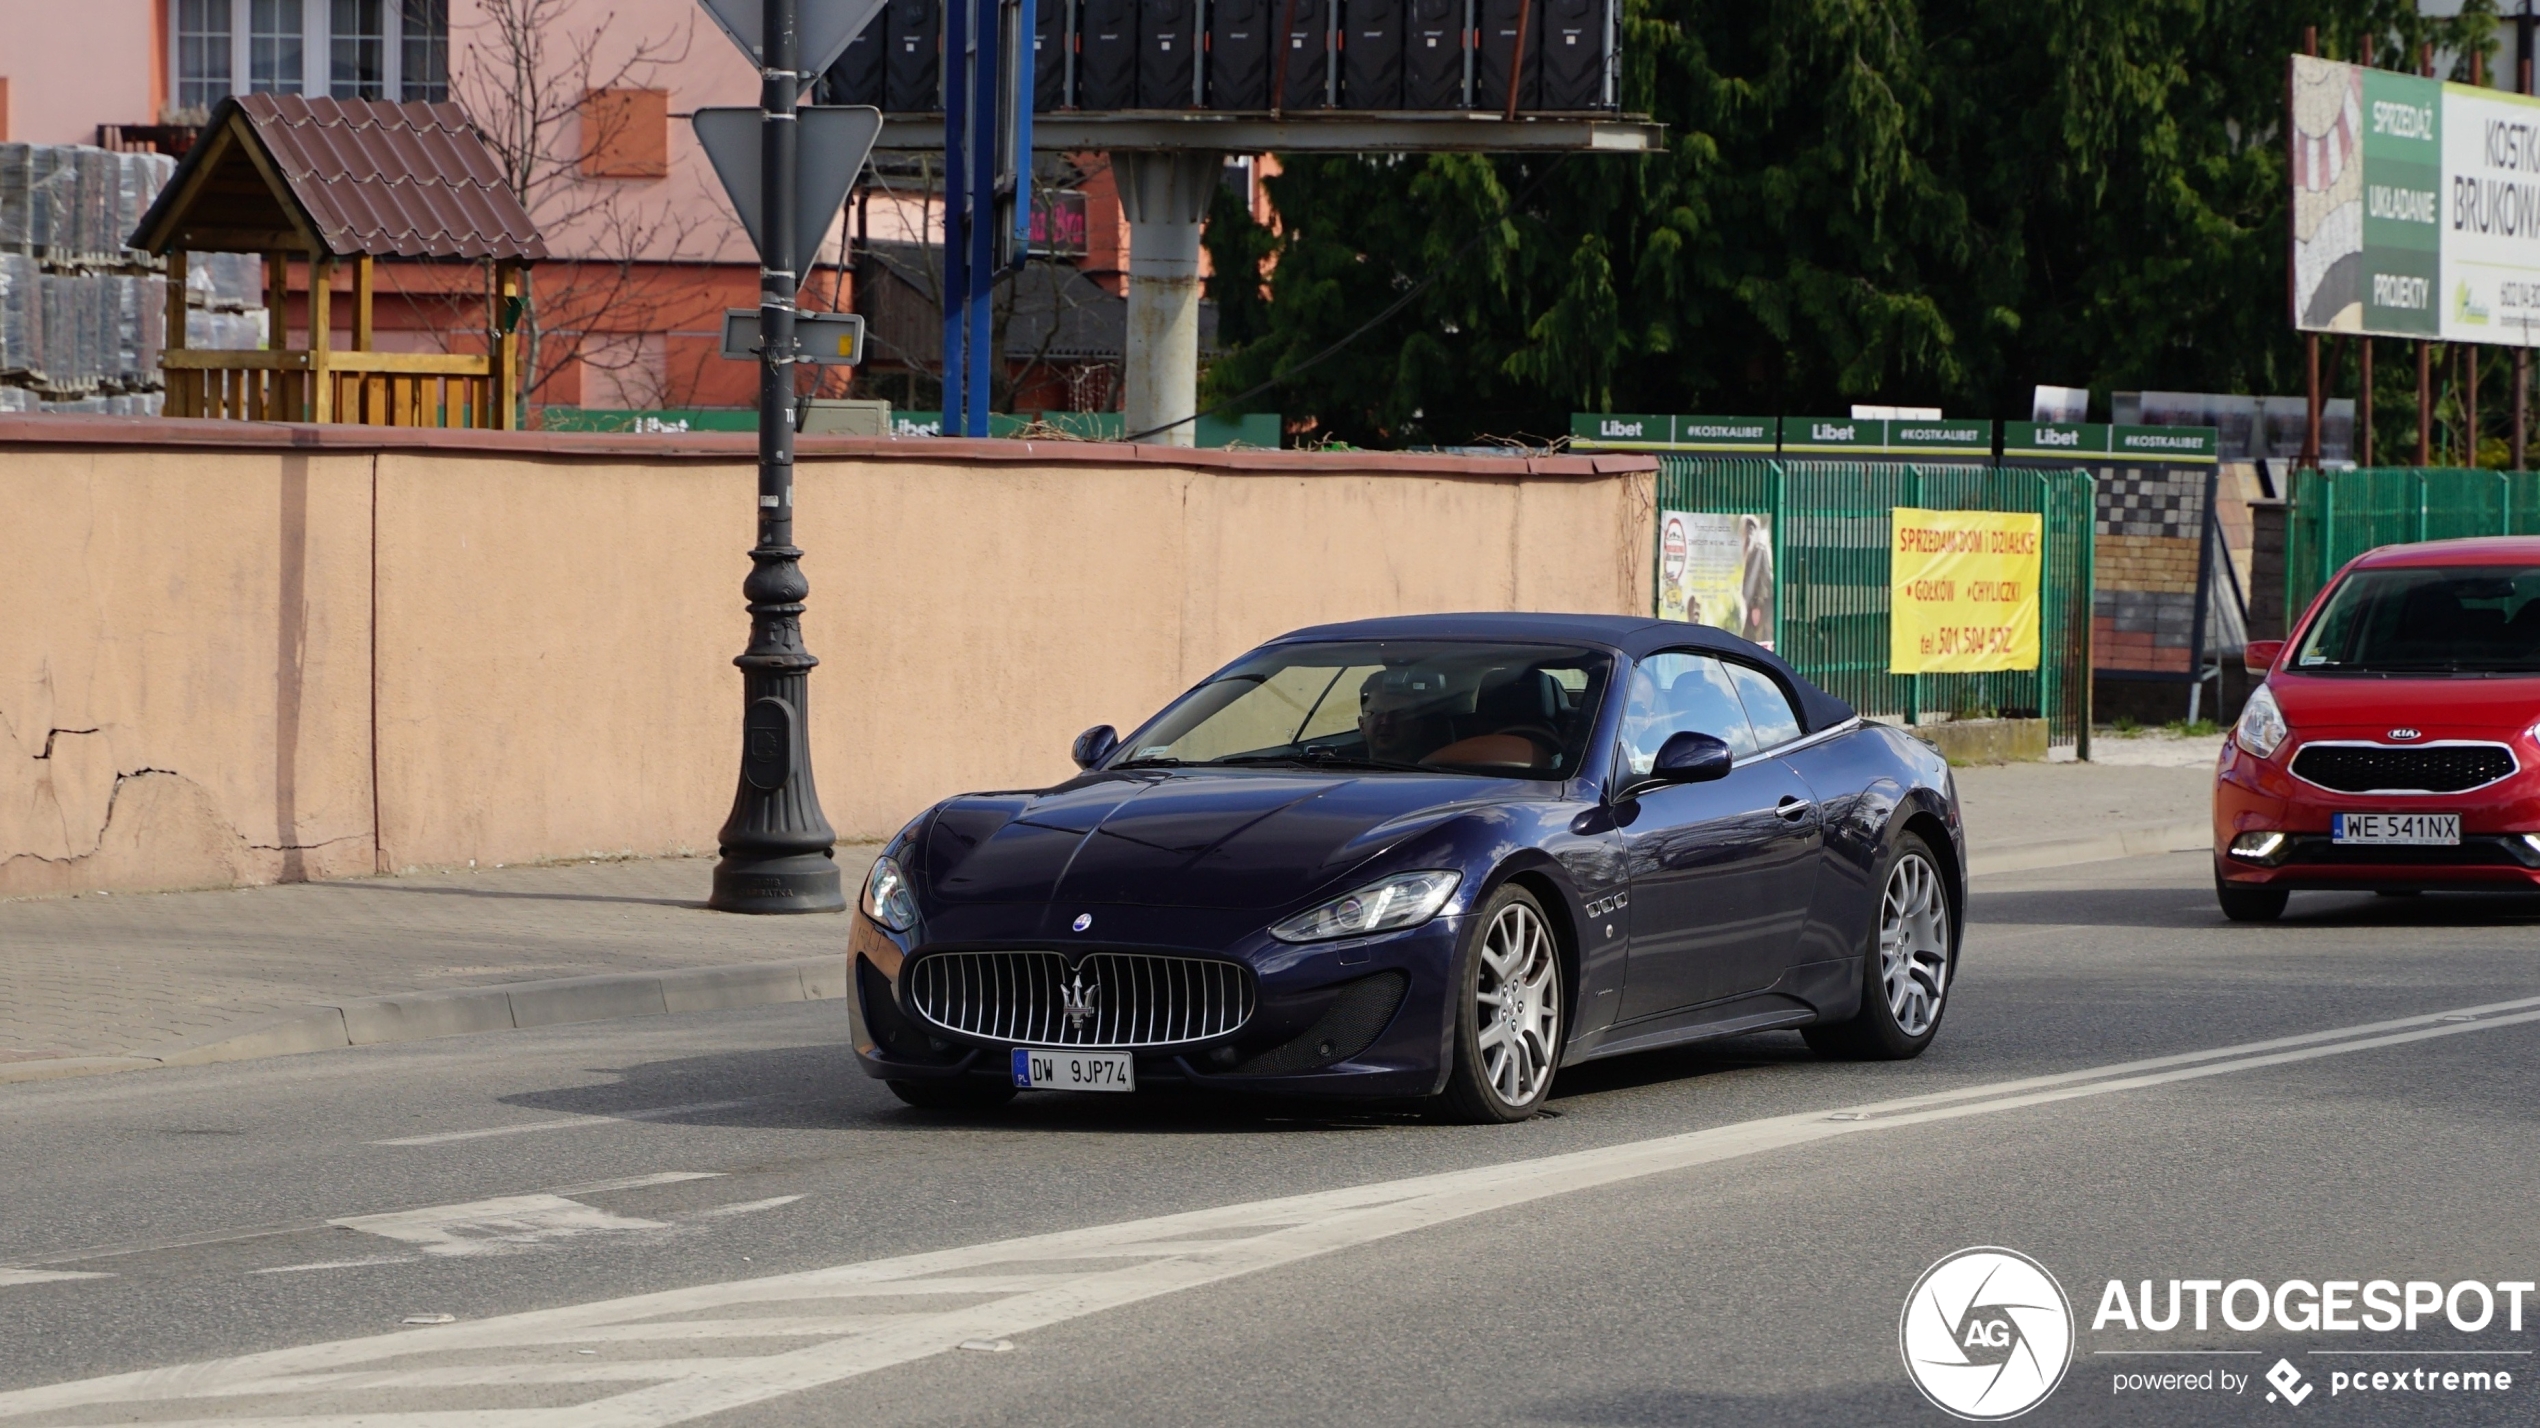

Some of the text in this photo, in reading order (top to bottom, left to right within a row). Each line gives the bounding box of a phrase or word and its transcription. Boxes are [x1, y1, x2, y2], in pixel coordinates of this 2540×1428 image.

[2484, 118, 2540, 173] KOSTK
[2369, 184, 2436, 224] UKŁADANIE
[2373, 273, 2430, 310] PROJEKTY
[1601, 420, 1643, 437] Libet
[1687, 425, 1764, 439] #KOSTKALIBET
[1811, 423, 1856, 441] Libet
[1900, 429, 1978, 442] #KOSTKALIBET
[2035, 428, 2079, 446] Libet
[2125, 435, 2205, 449] #KOSTKALIBET
[1900, 527, 1957, 553] SPRZEDAM
[1959, 530, 1982, 553] DOM
[1938, 627, 1960, 655] 501
[1963, 627, 1986, 654] 504
[2392, 729, 2416, 737] KIA
[2347, 816, 2457, 838] WE 541NX
[1017, 1074, 1028, 1083] PL
[1031, 1058, 1127, 1084] DW 9JP74
